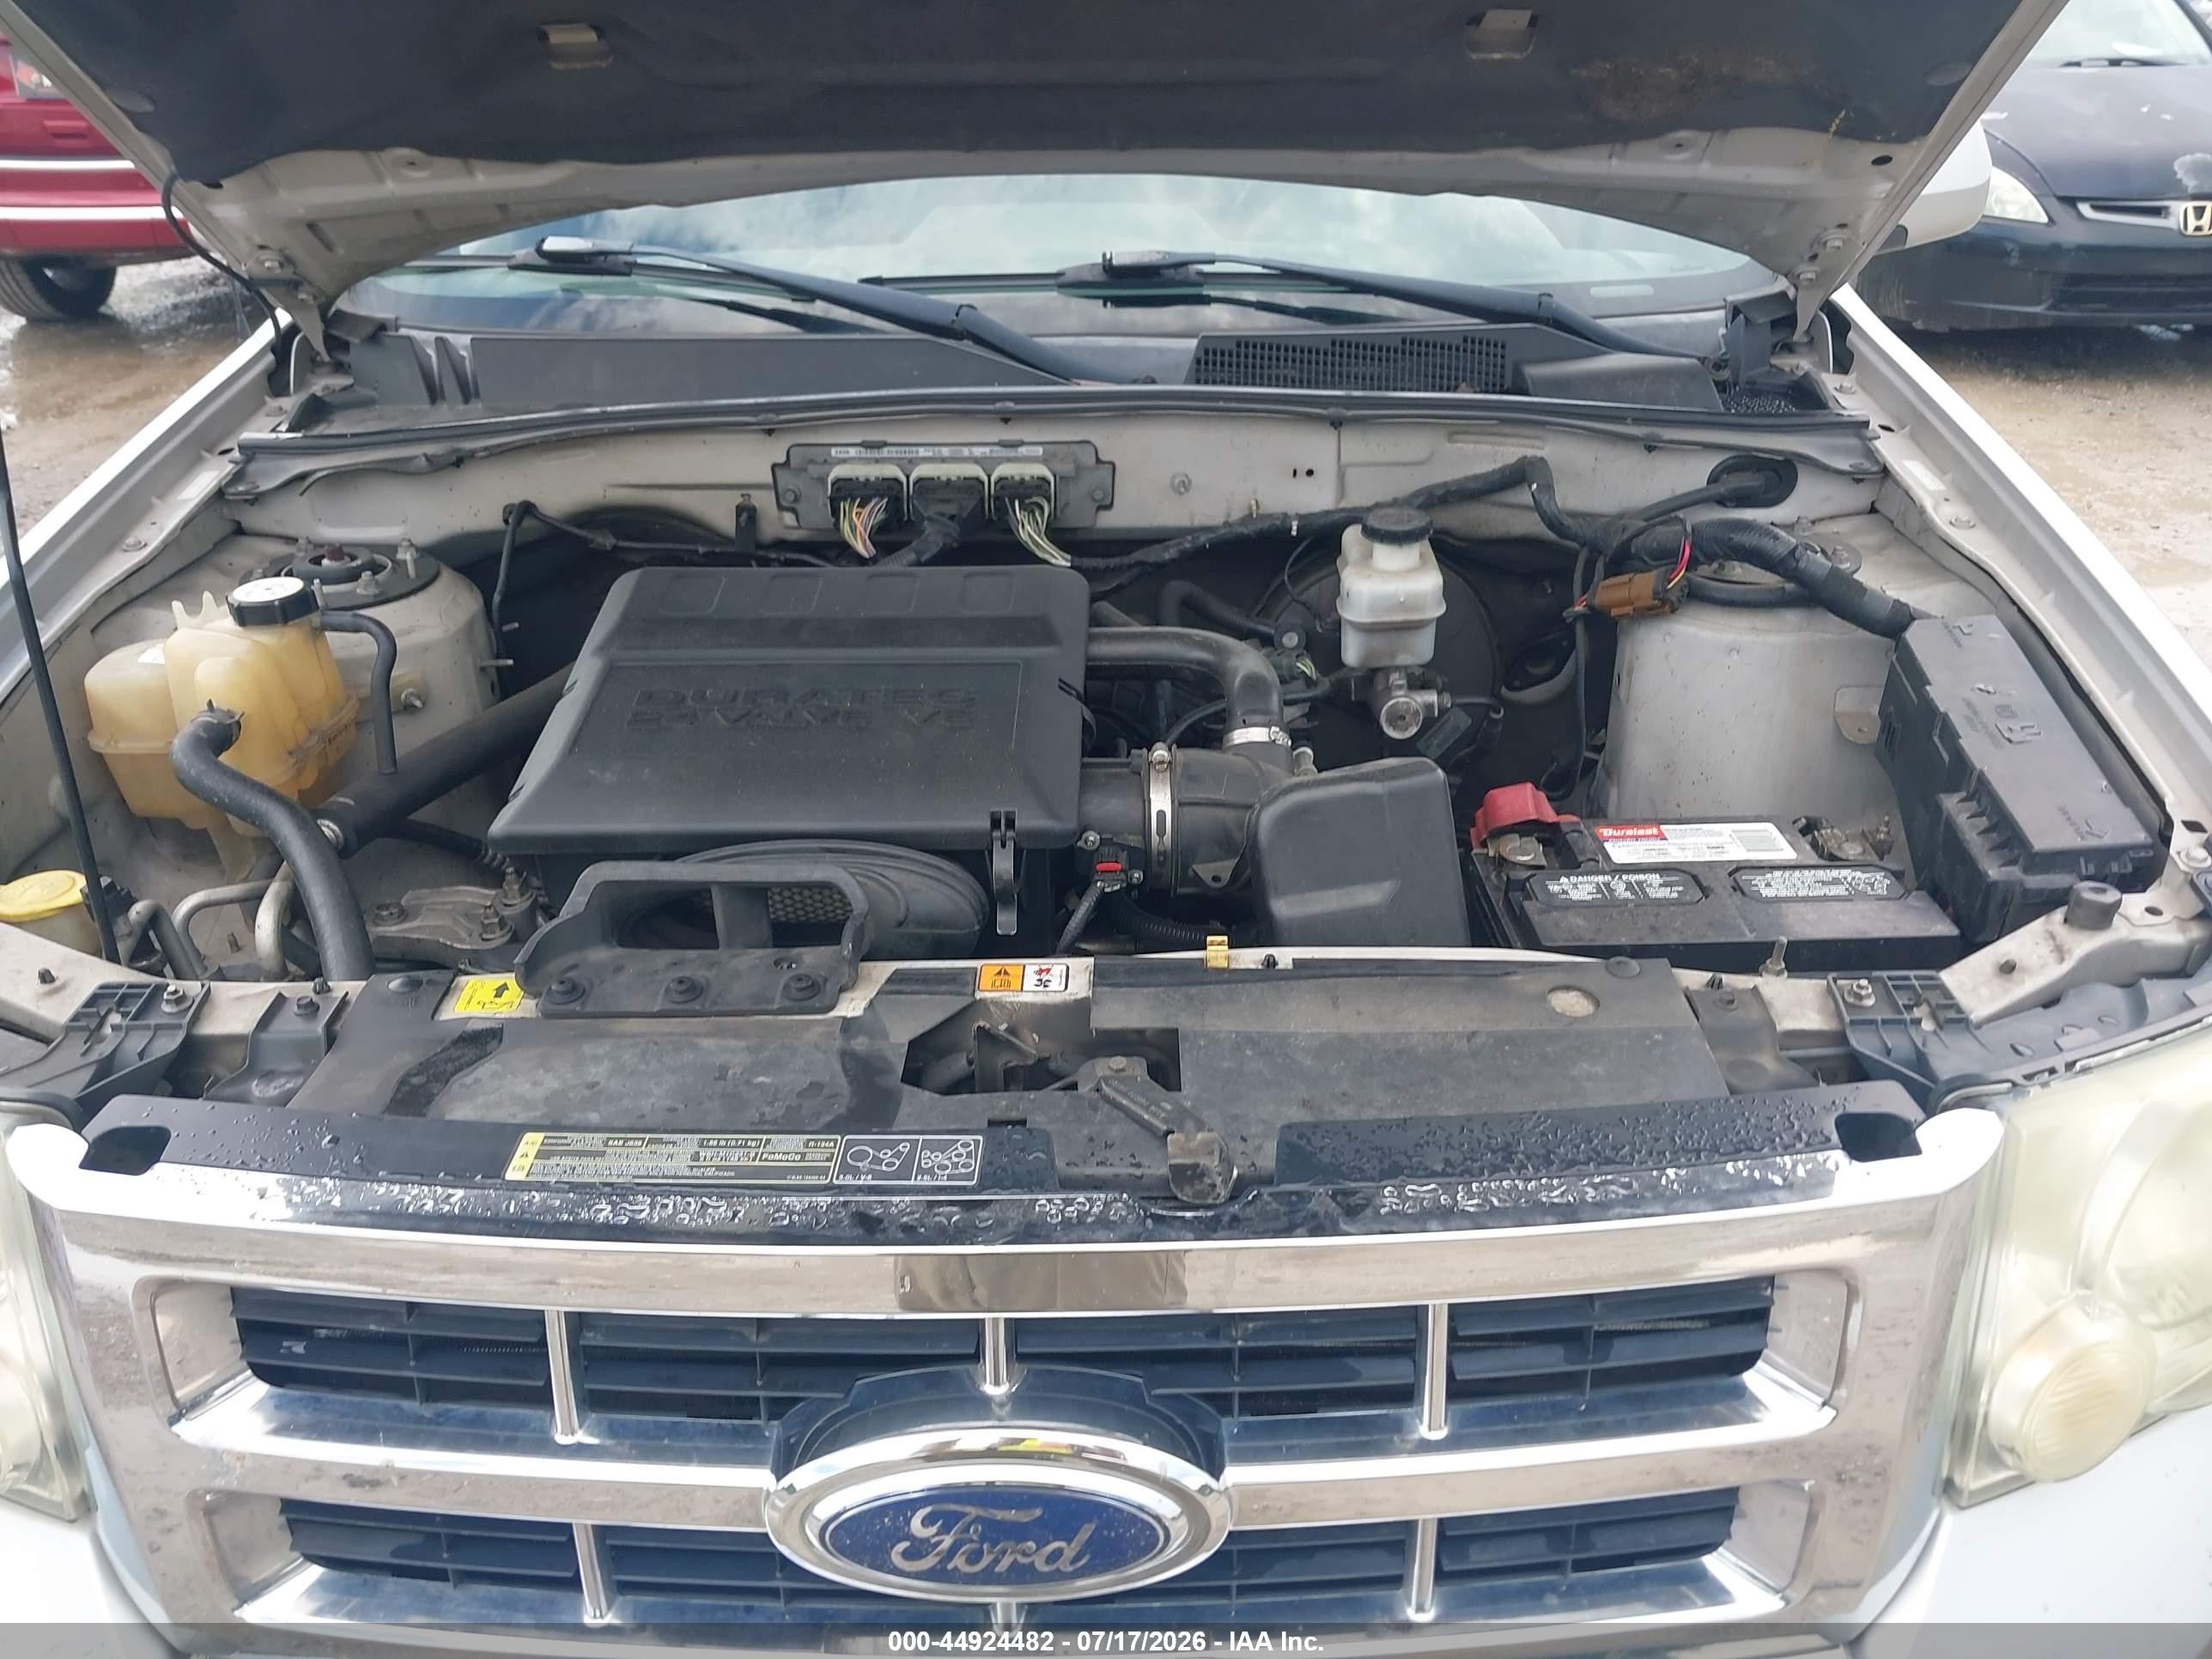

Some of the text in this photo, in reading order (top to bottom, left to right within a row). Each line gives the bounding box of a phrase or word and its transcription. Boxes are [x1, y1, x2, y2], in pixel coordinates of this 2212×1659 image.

[633, 688, 978, 707] DURATEC
[1599, 826, 1659, 837] Duralast
[1570, 874, 1612, 883] DANGER
[1621, 872, 1661, 882] POISON
[762, 1152, 801, 1162] FoMoCo
[891, 1503, 1097, 1573] Ford
